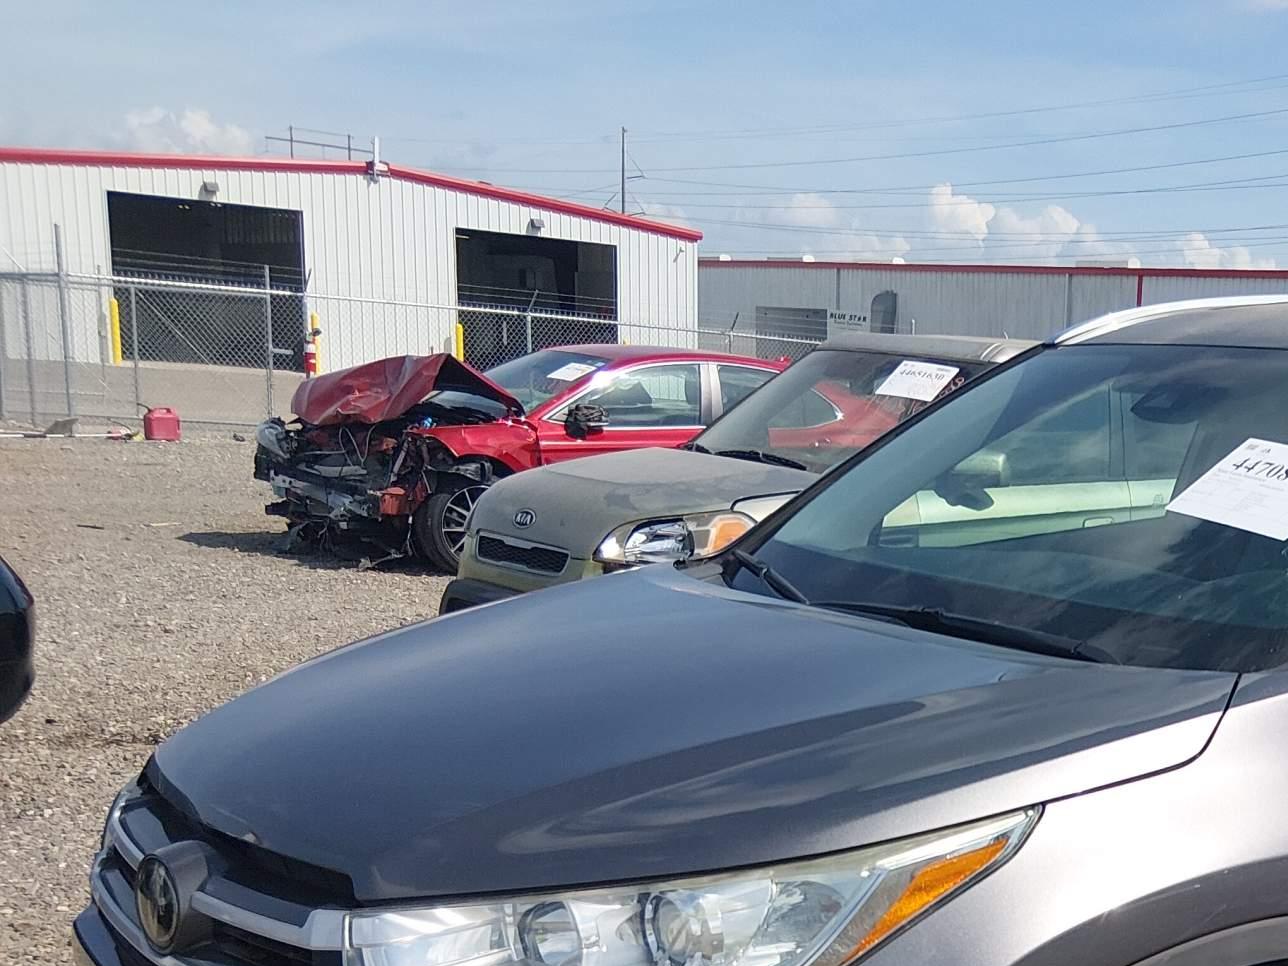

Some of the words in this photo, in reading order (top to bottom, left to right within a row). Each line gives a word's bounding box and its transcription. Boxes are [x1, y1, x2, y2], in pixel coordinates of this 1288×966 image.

[829, 312, 846, 320] BLUE
[848, 314, 867, 322] STAR
[516, 512, 531, 525] KIA
